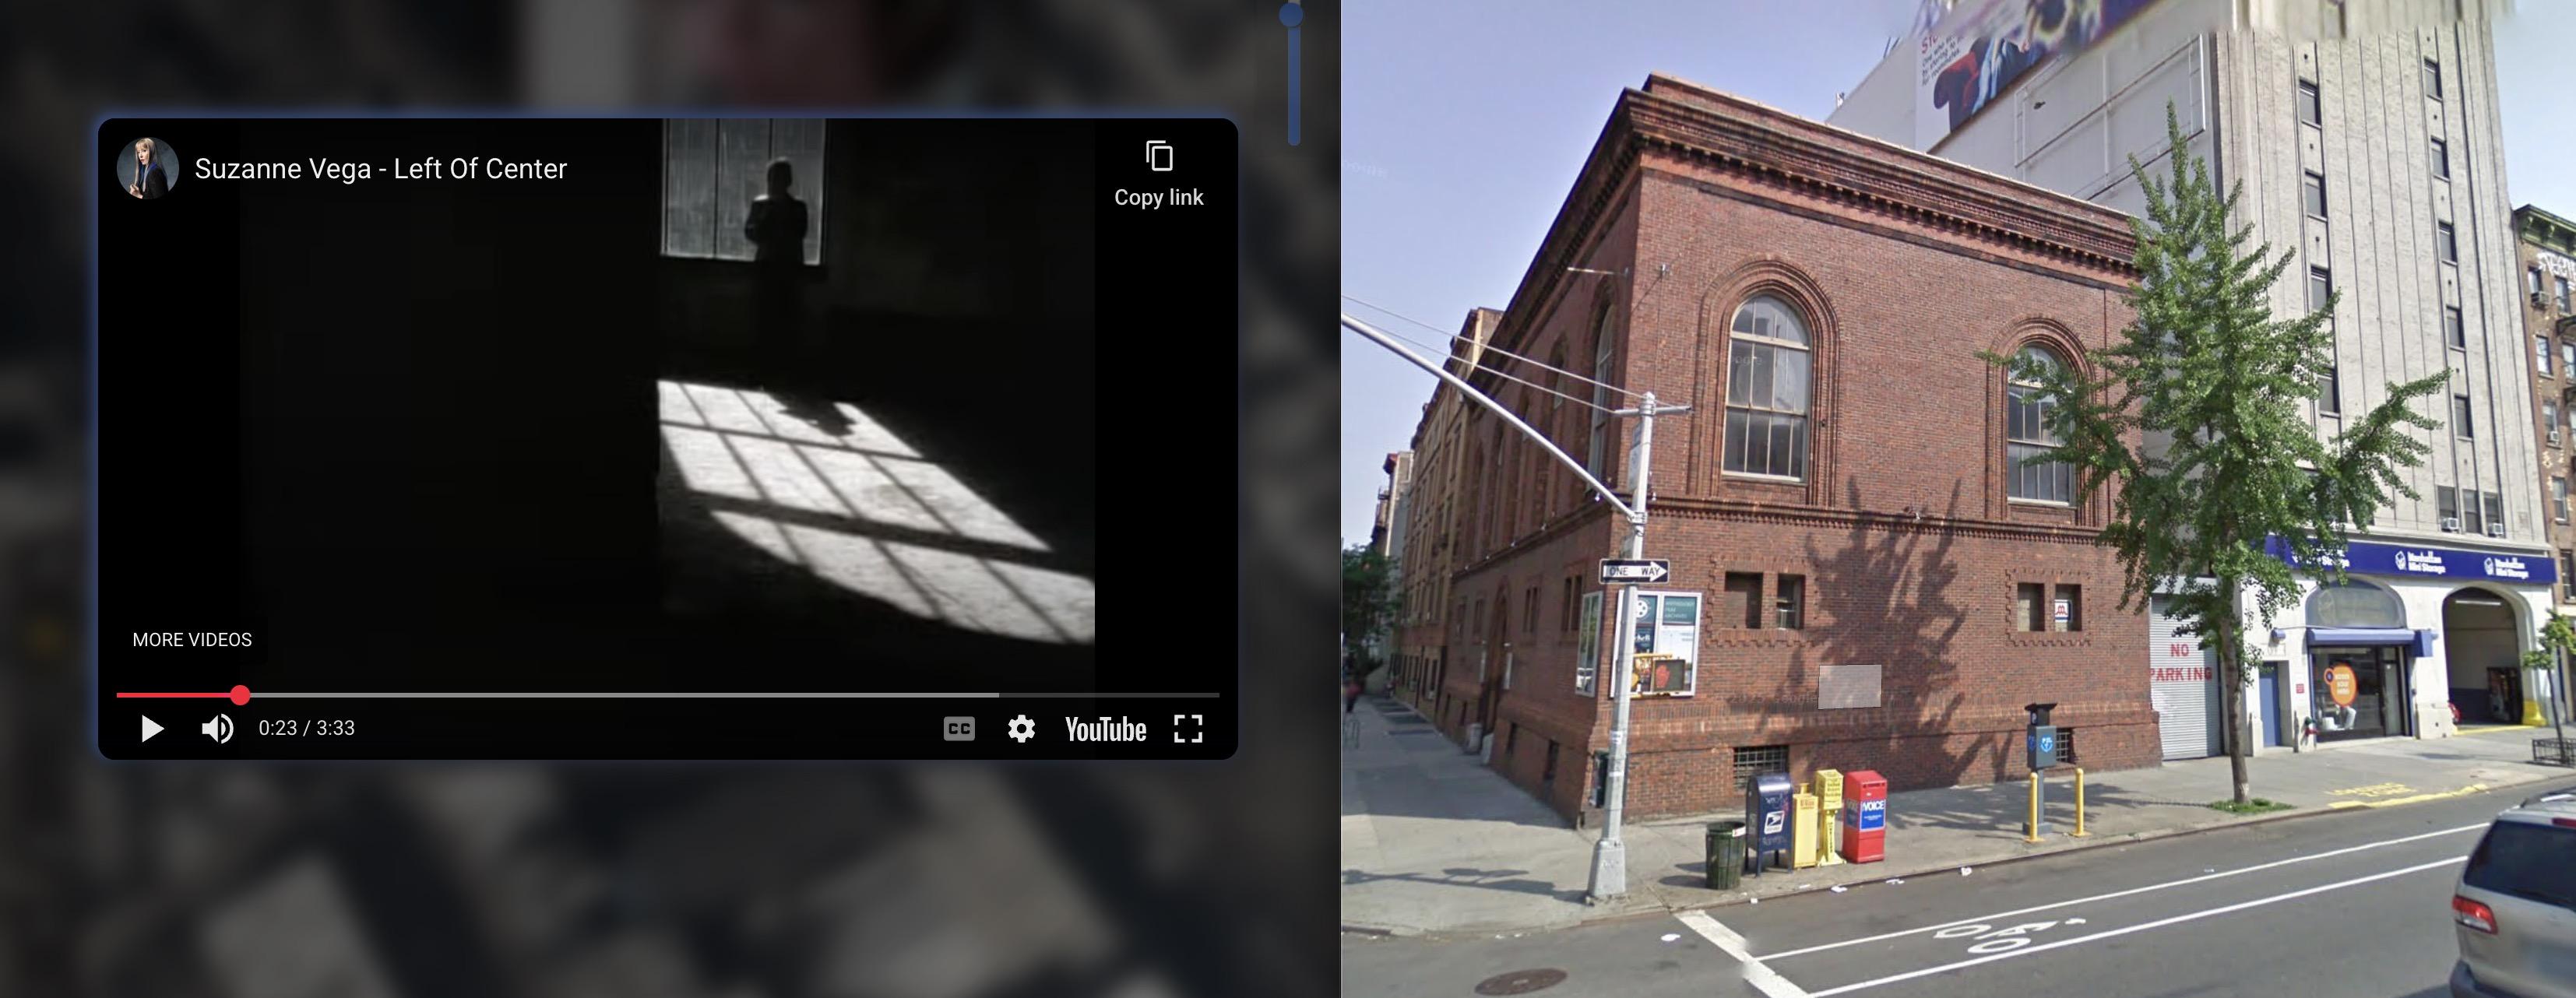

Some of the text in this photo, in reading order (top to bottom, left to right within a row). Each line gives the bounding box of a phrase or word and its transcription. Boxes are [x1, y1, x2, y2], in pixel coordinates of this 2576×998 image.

[195, 157, 301, 179] Suzanne
[308, 157, 371, 185] Vega
[395, 156, 442, 179] Left
[450, 156, 479, 179] Of
[486, 157, 568, 180] Center
[1114, 188, 1205, 210] Copy link
[1610, 567, 1660, 576] ONE WAY
[133, 632, 252, 647] MORE VIDEOS
[2170, 644, 2190, 657] NO
[2148, 667, 2212, 682] PARKING
[259, 719, 355, 737] 0:23 / 3:33
[948, 722, 970, 735] CC
[1065, 715, 1147, 742] YouTube
[1863, 800, 1885, 811] VOICE
